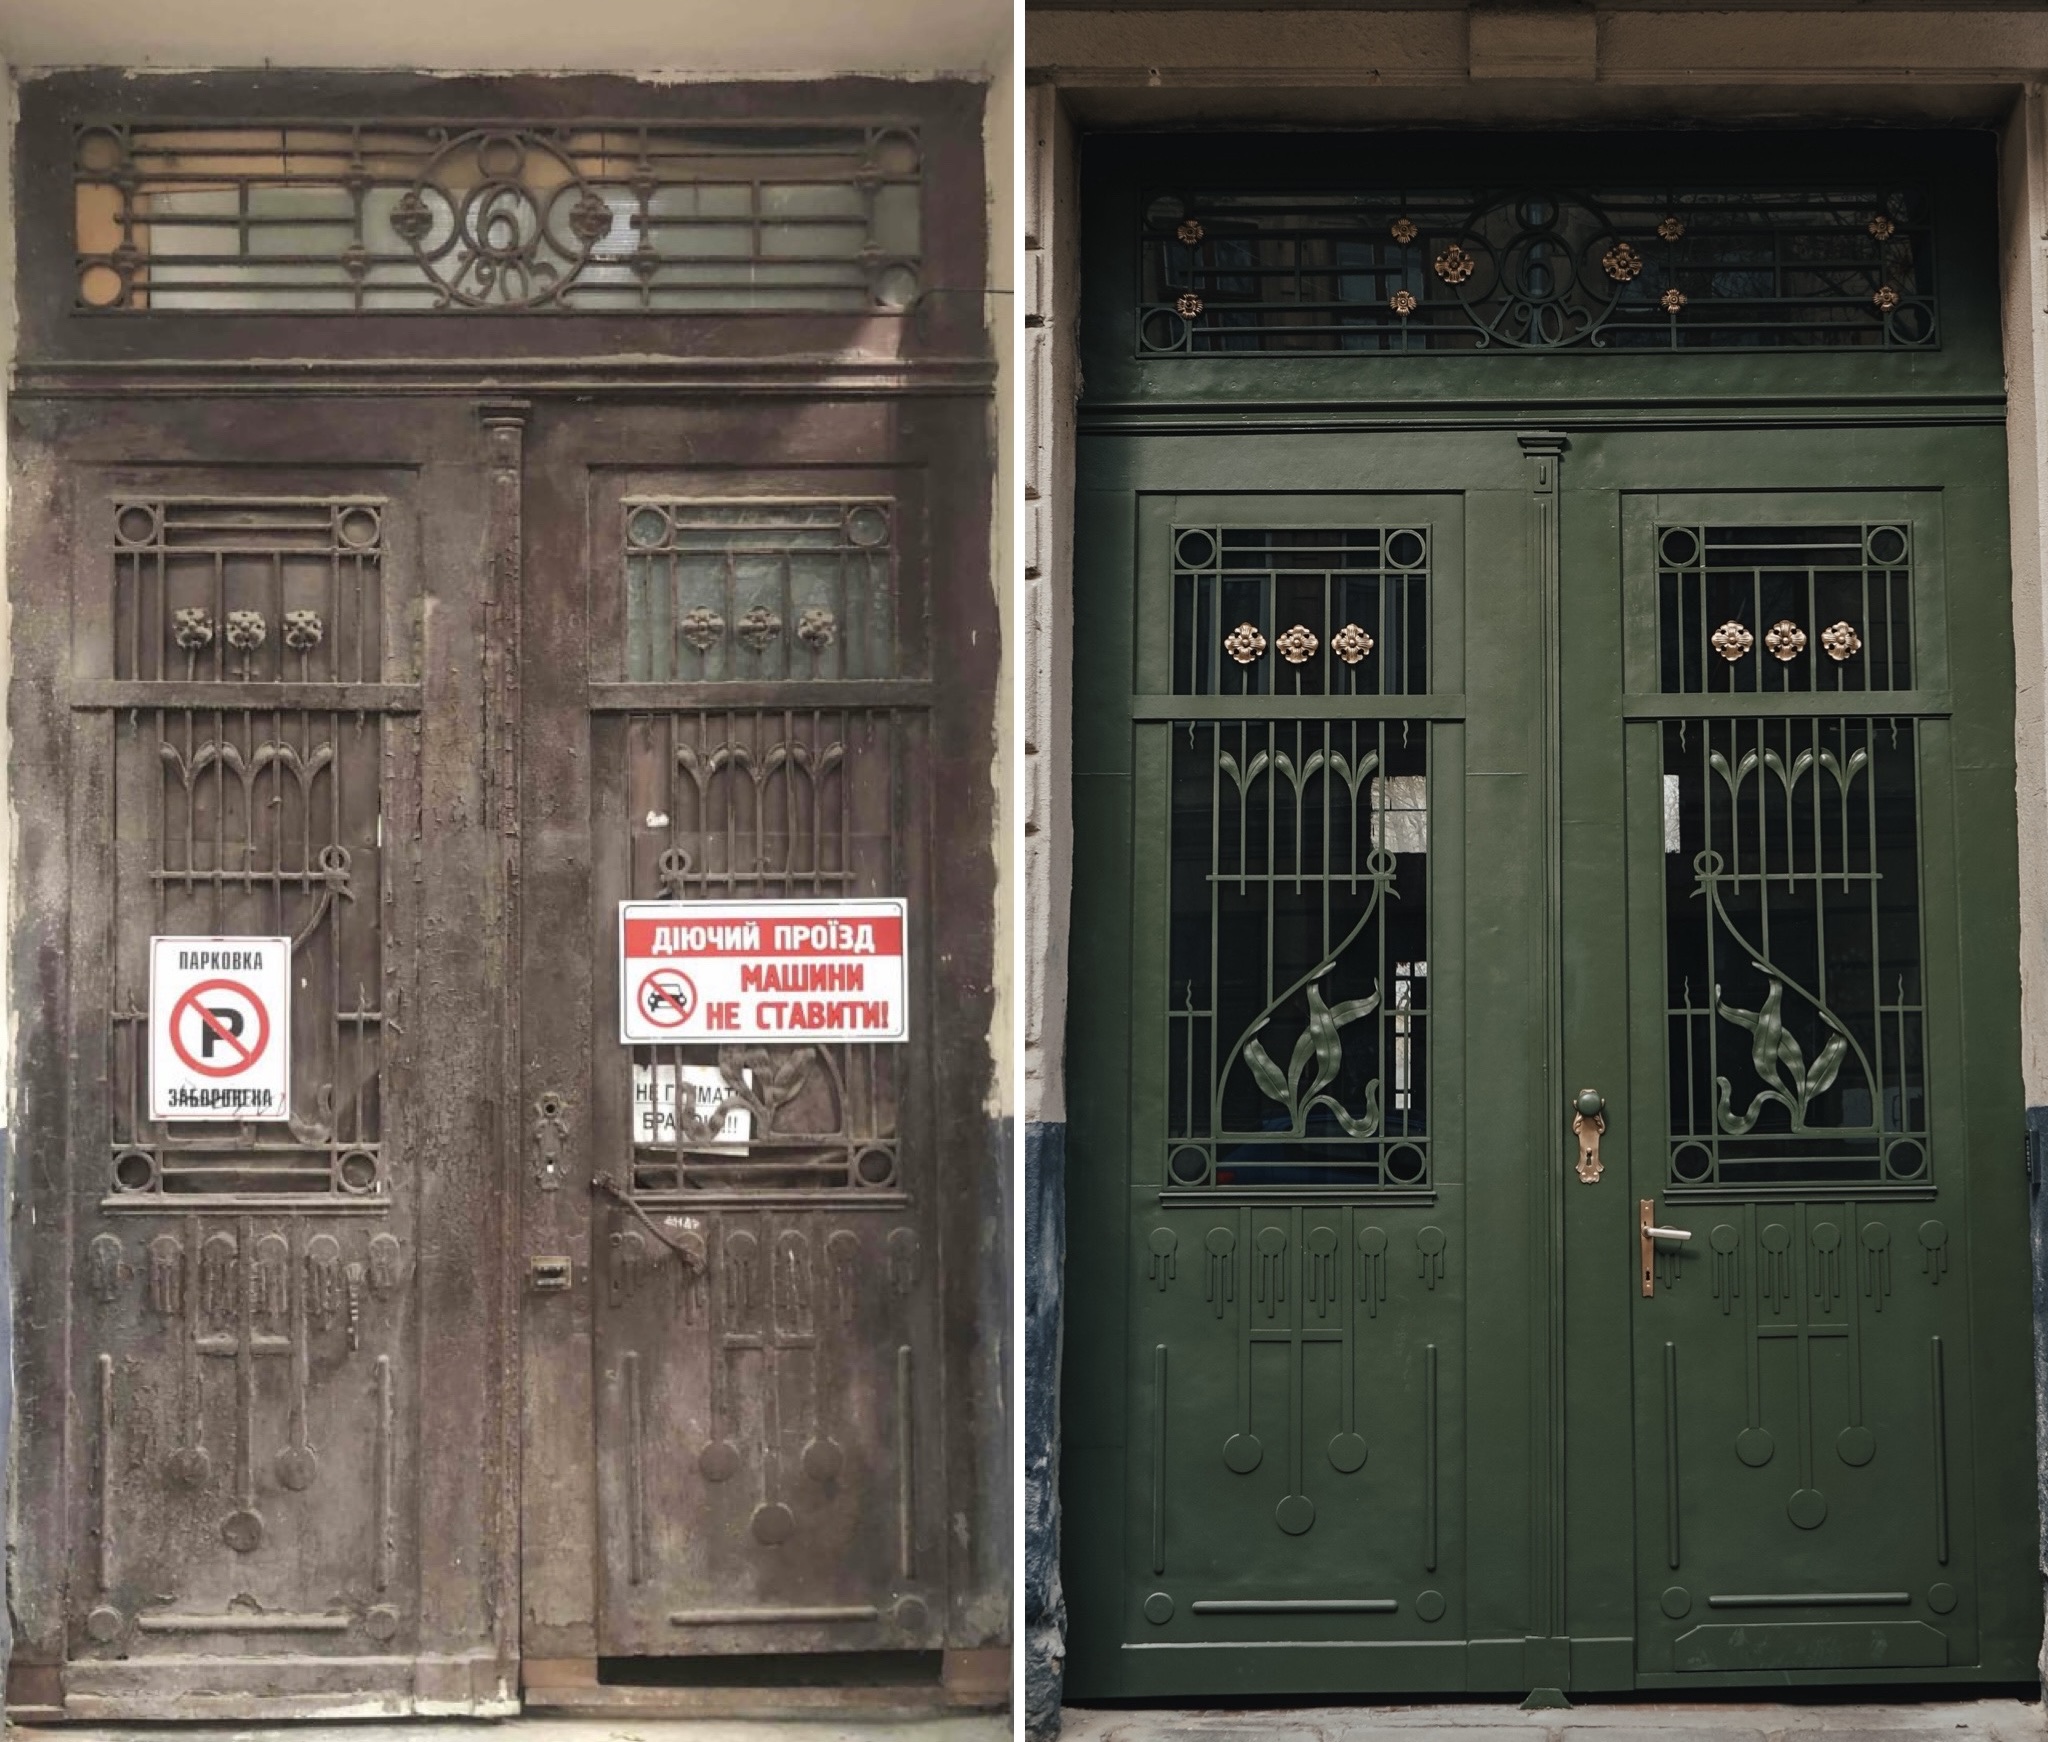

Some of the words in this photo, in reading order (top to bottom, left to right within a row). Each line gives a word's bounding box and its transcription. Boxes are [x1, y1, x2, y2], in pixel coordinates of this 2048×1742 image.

[476, 183, 520, 254] 6
[1516, 237, 1556, 301] 6
[1488, 293, 1593, 343] 1905
[652, 920, 760, 955] ДІЮЧИЙ
[774, 919, 876, 954] ПРОЇЗД
[179, 951, 263, 970] ПАРКОВКА
[741, 964, 864, 992] МАШИНИ
[706, 1002, 740, 1030] НЕ
[756, 1001, 889, 1030] СТАВИТИ!
